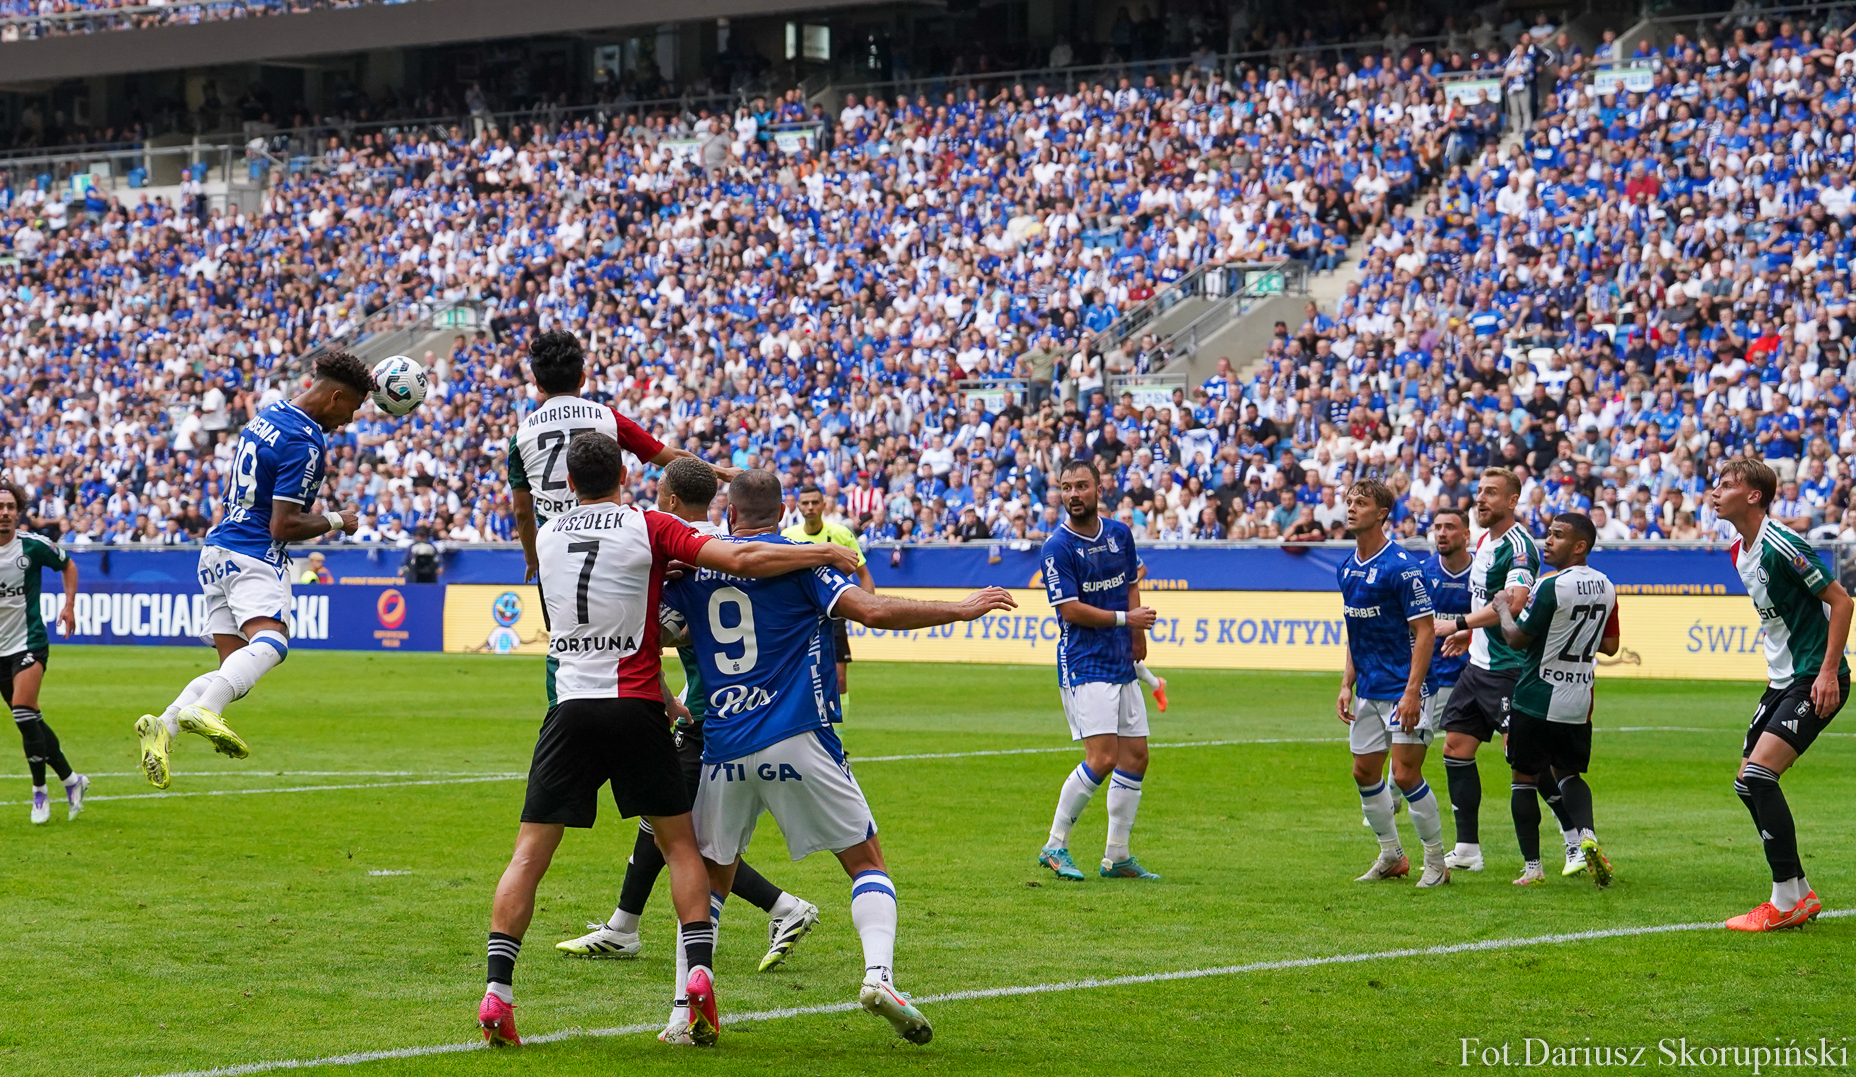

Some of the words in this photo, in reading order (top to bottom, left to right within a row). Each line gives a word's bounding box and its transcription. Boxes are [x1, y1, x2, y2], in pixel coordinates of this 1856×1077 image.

[528, 405, 602, 427] MORISHITA
[228, 435, 257, 510] 19
[537, 427, 597, 491] 2
[535, 497, 579, 513] FORT
[567, 540, 600, 624] 7
[40, 592, 209, 637] PERPUCHAR
[289, 595, 329, 639] SKI
[708, 586, 759, 675] 9
[1344, 604, 1381, 618] PERBET
[550, 636, 638, 652] FORTUNA
[965, 615, 1057, 647] TYSIĘC
[1195, 619, 1208, 643] 5
[1217, 620, 1347, 646] KONTYN
[1558, 603, 1607, 664] 22
[1542, 667, 1595, 684] FORTU
